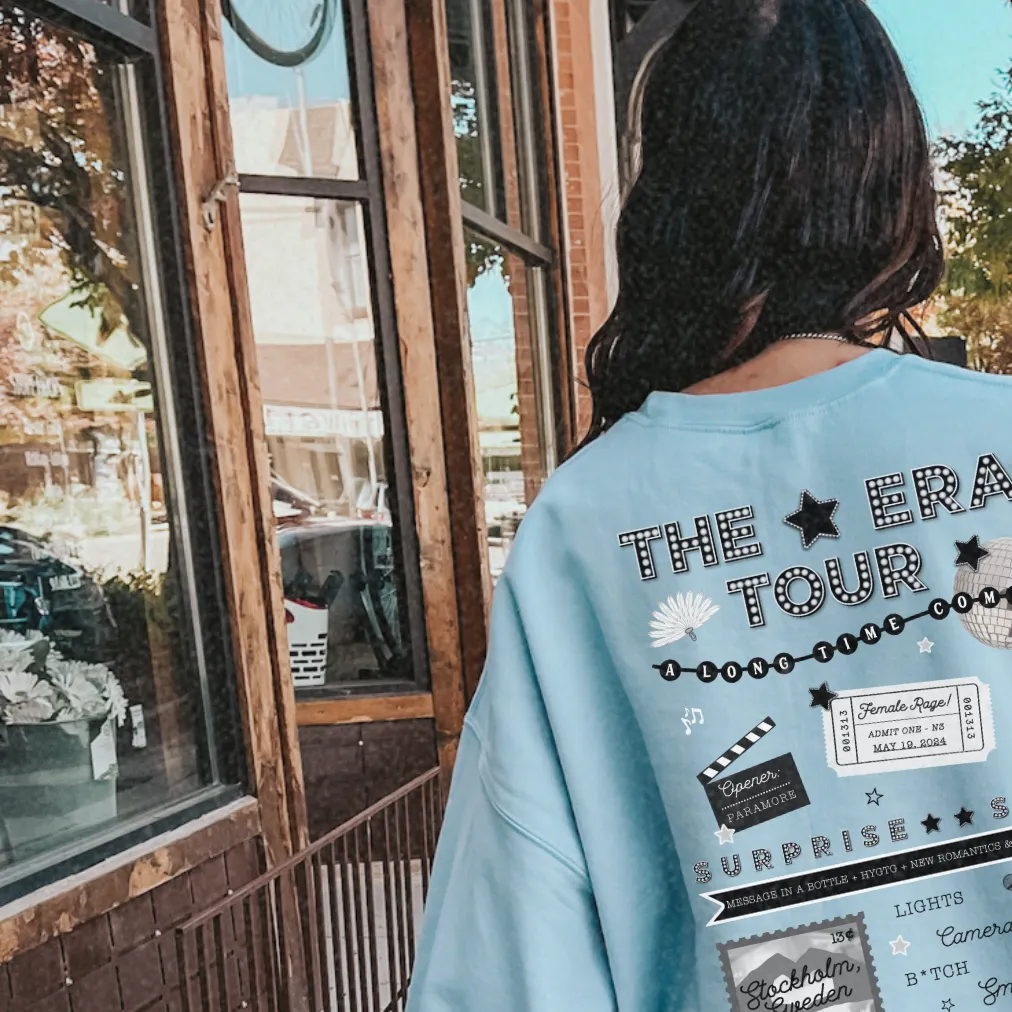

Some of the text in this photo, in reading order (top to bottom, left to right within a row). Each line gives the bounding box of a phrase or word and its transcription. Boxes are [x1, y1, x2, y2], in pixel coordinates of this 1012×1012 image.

[617, 504, 763, 581] THE
[726, 542, 929, 629] TOUR
[700, 655, 791, 680] LONG
[816, 614, 902, 661] TIME
[857, 694, 952, 720] Female Rage!
[867, 727, 900, 738] ADMIT
[901, 725, 922, 735] ONE
[931, 722, 945, 732] N3
[873, 742, 897, 753] MAY
[919, 736, 948, 748] 2024
[717, 769, 780, 798] Opener:
[726, 789, 797, 823] PARAMORE
[693, 817, 909, 884] SURPRISE
[725, 890, 778, 909] MESSAGE
[779, 887, 794, 898] IN
[796, 884, 805, 896] A
[807, 874, 849, 893] BOTTLE
[859, 864, 898, 882] HYGTG
[909, 855, 935, 870] NEW
[937, 841, 1002, 863] ROMANTICS
[894, 891, 964, 918] LIGHTS
[740, 956, 861, 1011] Stockholm,
